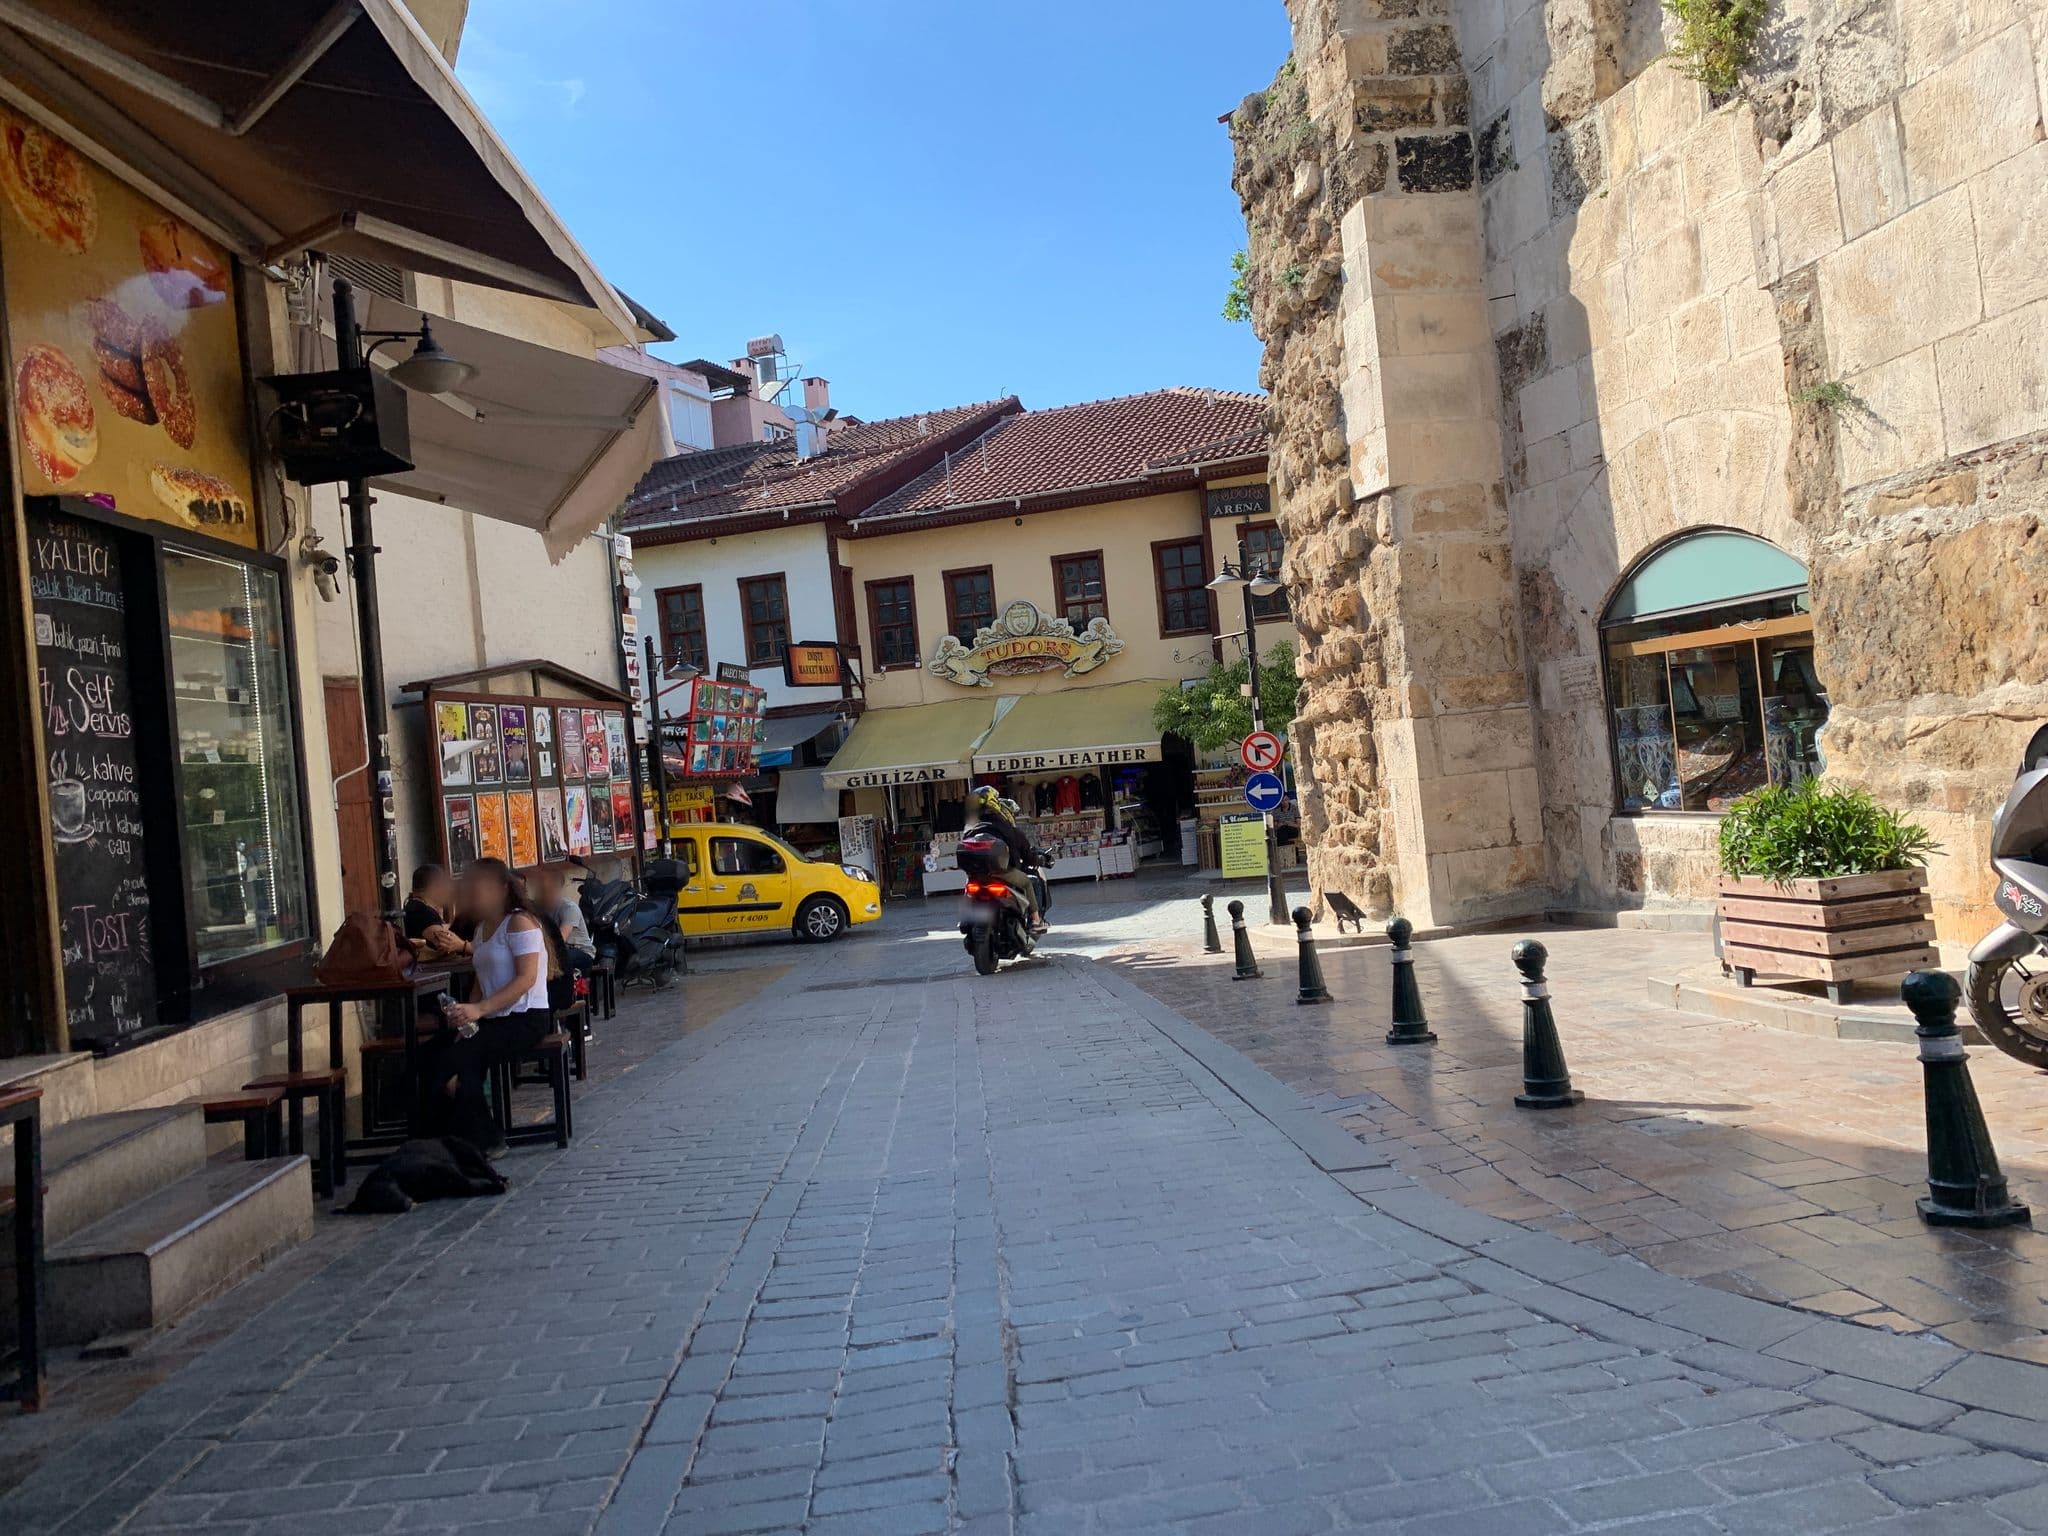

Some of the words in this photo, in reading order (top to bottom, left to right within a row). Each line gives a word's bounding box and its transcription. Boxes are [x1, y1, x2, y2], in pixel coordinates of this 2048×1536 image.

[1213, 502, 1264, 516] ARENA
[980, 640, 1072, 661] TUDORS
[92, 752, 134, 783] kahve
[846, 767, 946, 788] GÜLİZAR
[108, 838, 131, 864] çay
